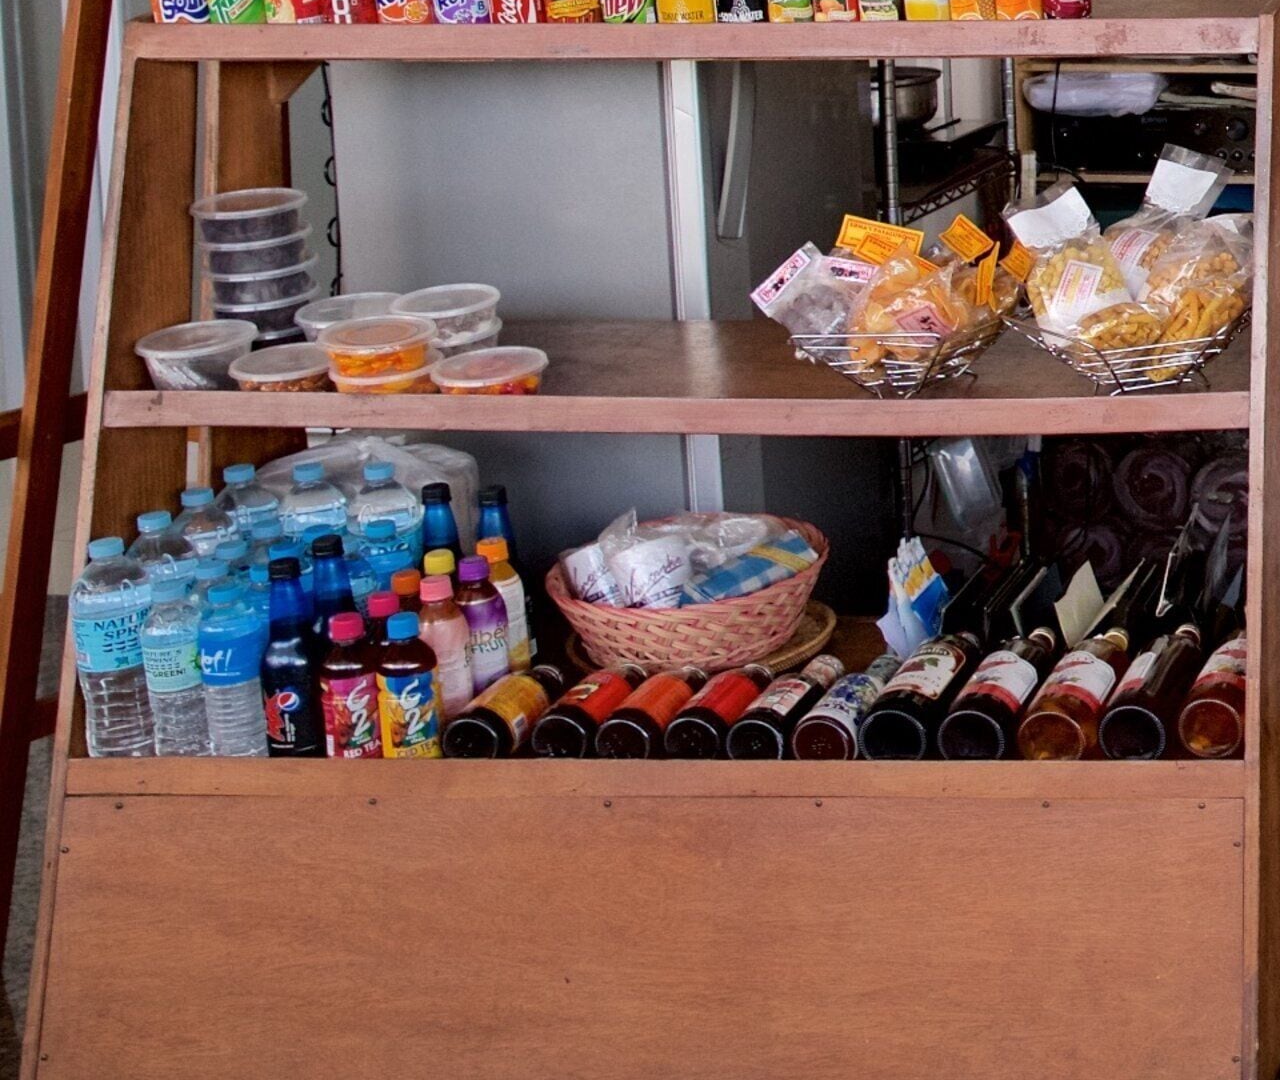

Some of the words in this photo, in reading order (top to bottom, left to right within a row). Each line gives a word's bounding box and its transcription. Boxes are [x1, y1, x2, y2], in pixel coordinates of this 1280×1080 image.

[93, 607, 151, 632] NATUR
[103, 627, 139, 642] SPR
[364, 739, 382, 752] TEA
[420, 738, 439, 753] TEA
